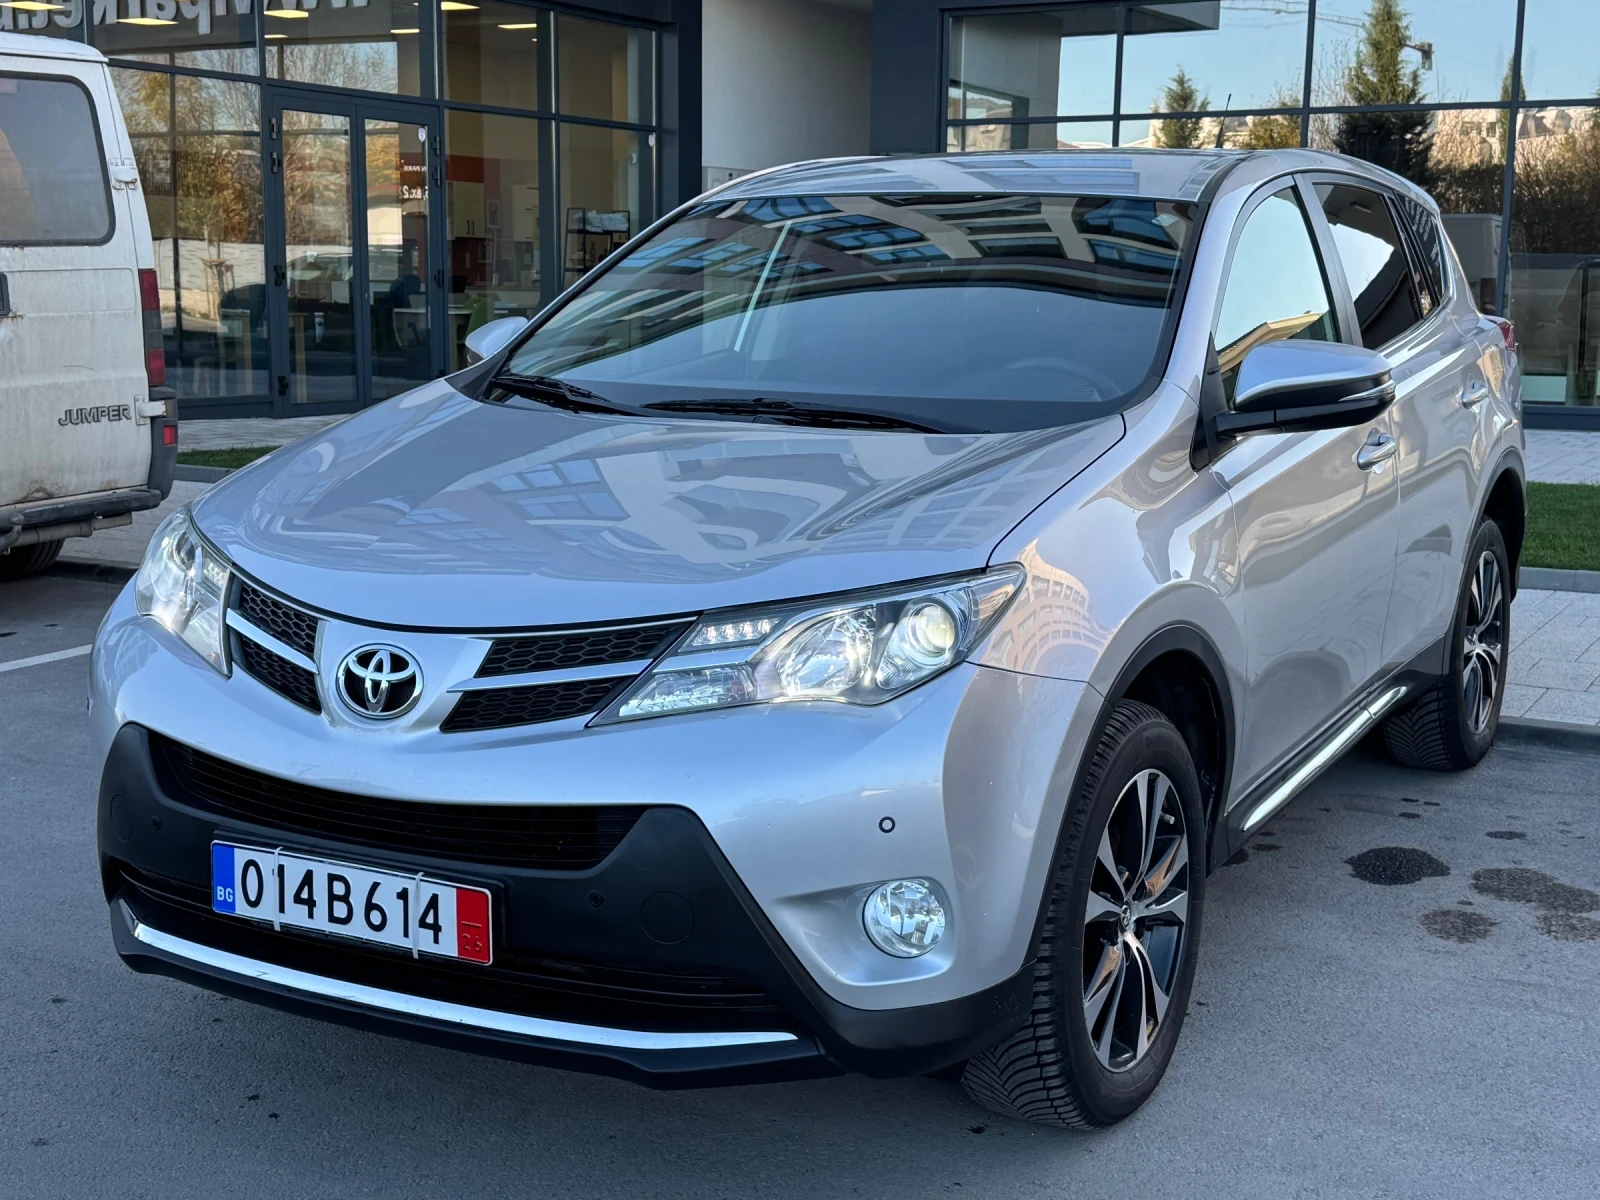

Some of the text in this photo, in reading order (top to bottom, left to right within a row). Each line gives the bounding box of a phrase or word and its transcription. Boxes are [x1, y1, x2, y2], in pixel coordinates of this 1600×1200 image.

[58, 404, 132, 426] JUMPER
[216, 858, 443, 945] BG 014B614
[462, 933, 483, 952] 26
